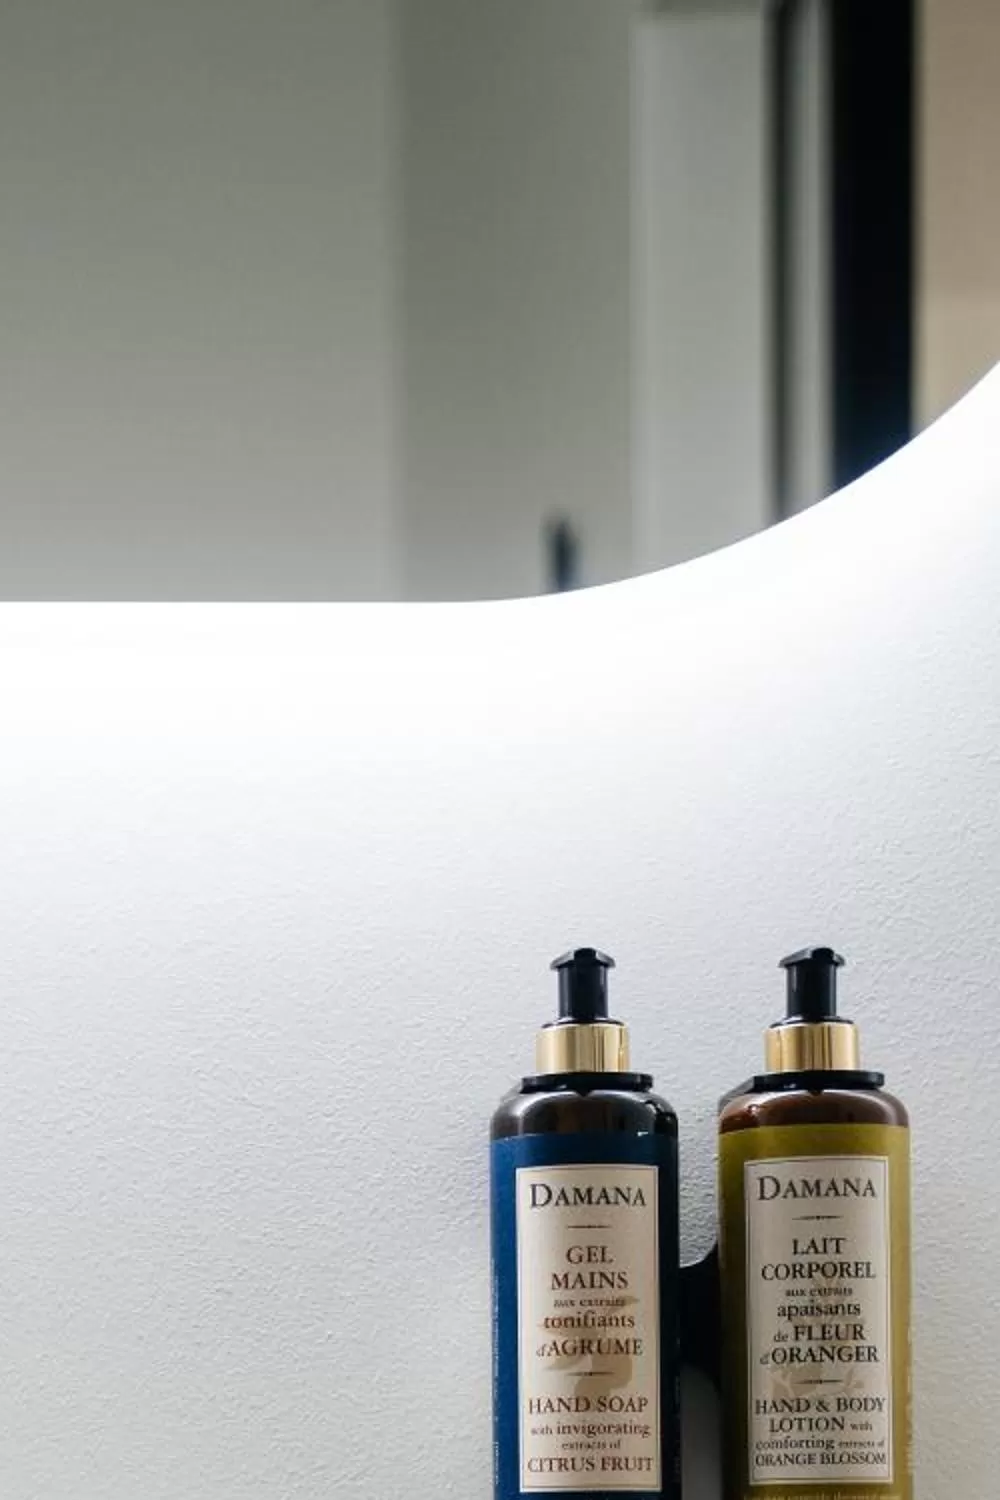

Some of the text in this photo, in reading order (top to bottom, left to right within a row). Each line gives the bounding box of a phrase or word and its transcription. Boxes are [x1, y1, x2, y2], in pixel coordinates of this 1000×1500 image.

[530, 1184, 647, 1208] DAMANA
[757, 1176, 877, 1200] DAMANA
[566, 1246, 613, 1264] GEL
[792, 1238, 846, 1255] LAIT
[761, 1261, 876, 1280] CORPOREL
[551, 1271, 628, 1290] MAINS
[777, 1300, 861, 1320] apaisants
[543, 1310, 635, 1329] tonifiants
[773, 1324, 866, 1342] de FLEUR
[529, 1395, 648, 1414] HAND SOAP
[755, 1397, 886, 1414] HAND & BODY
[557, 1420, 651, 1438] invigorating
[769, 1416, 845, 1433] LOTION
[755, 1435, 835, 1451] comforting
[527, 1456, 654, 1473] CITRUS FRUIT
[755, 1451, 886, 1467] ORANGE BLOSSOM
